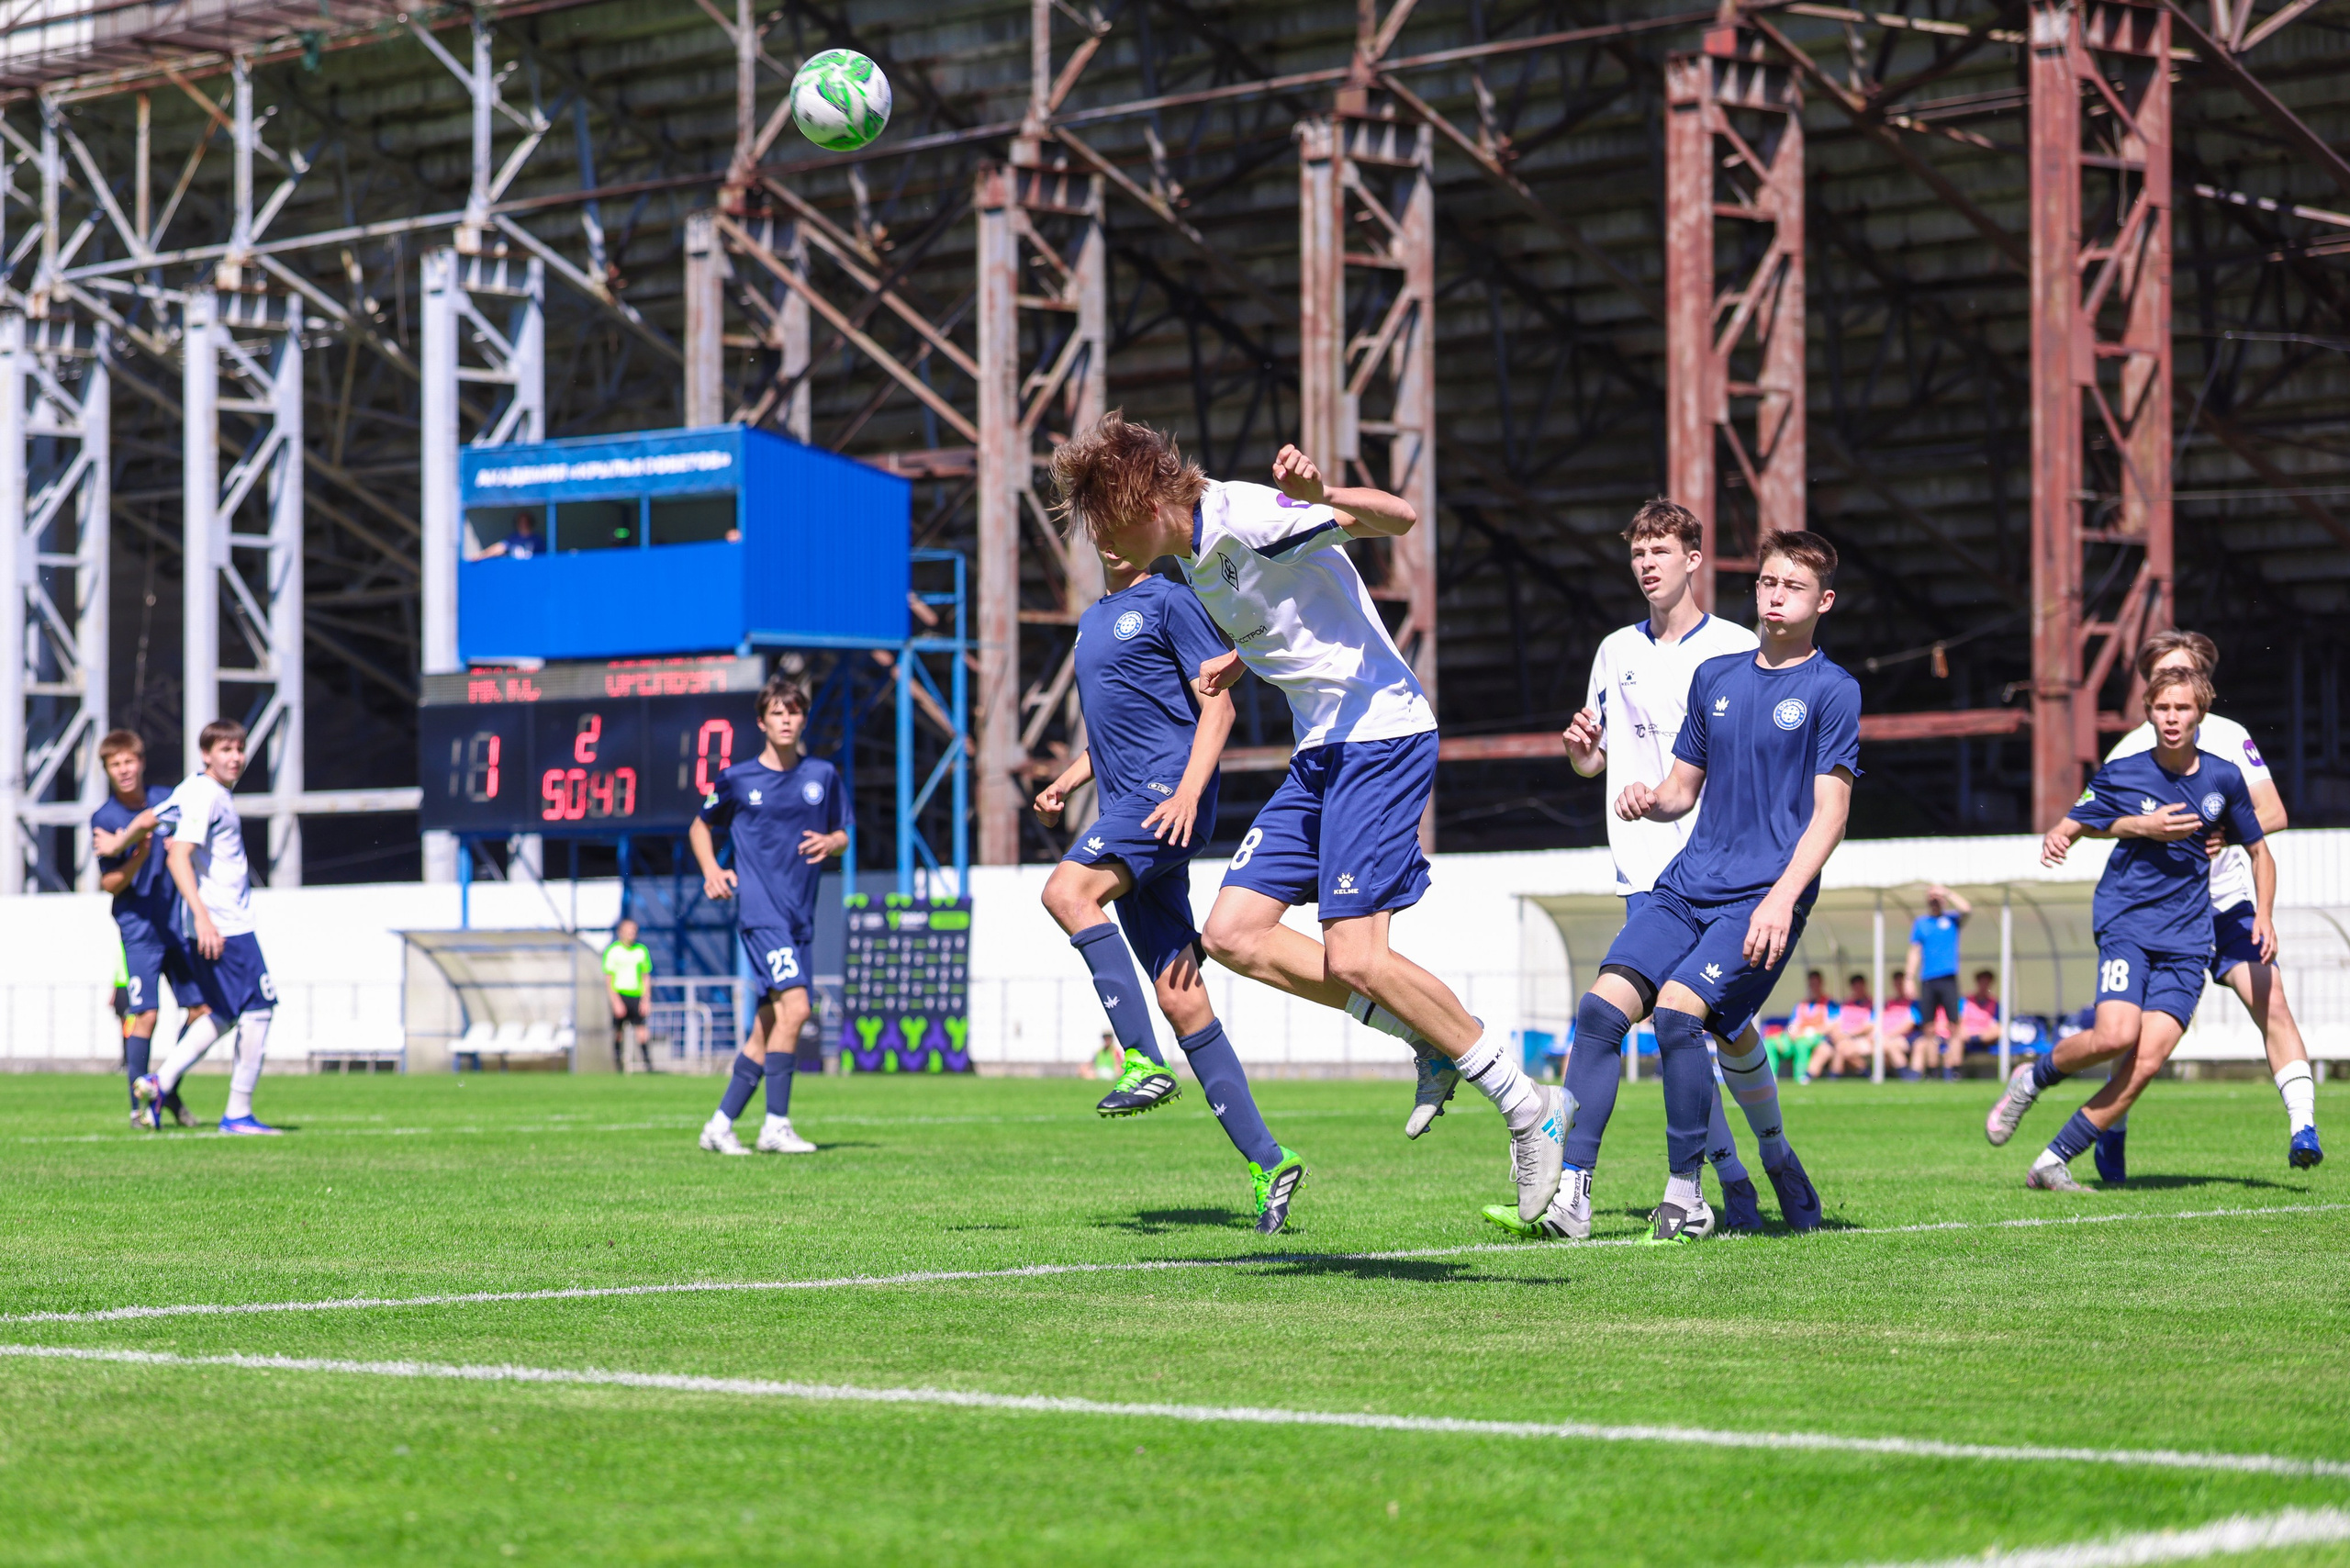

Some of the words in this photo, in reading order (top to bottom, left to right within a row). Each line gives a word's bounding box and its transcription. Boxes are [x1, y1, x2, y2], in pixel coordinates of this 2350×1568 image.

[575, 713, 602, 764] 2
[1229, 827, 1264, 870] 8
[766, 946, 800, 984] 23
[2099, 958, 2130, 993] 18
